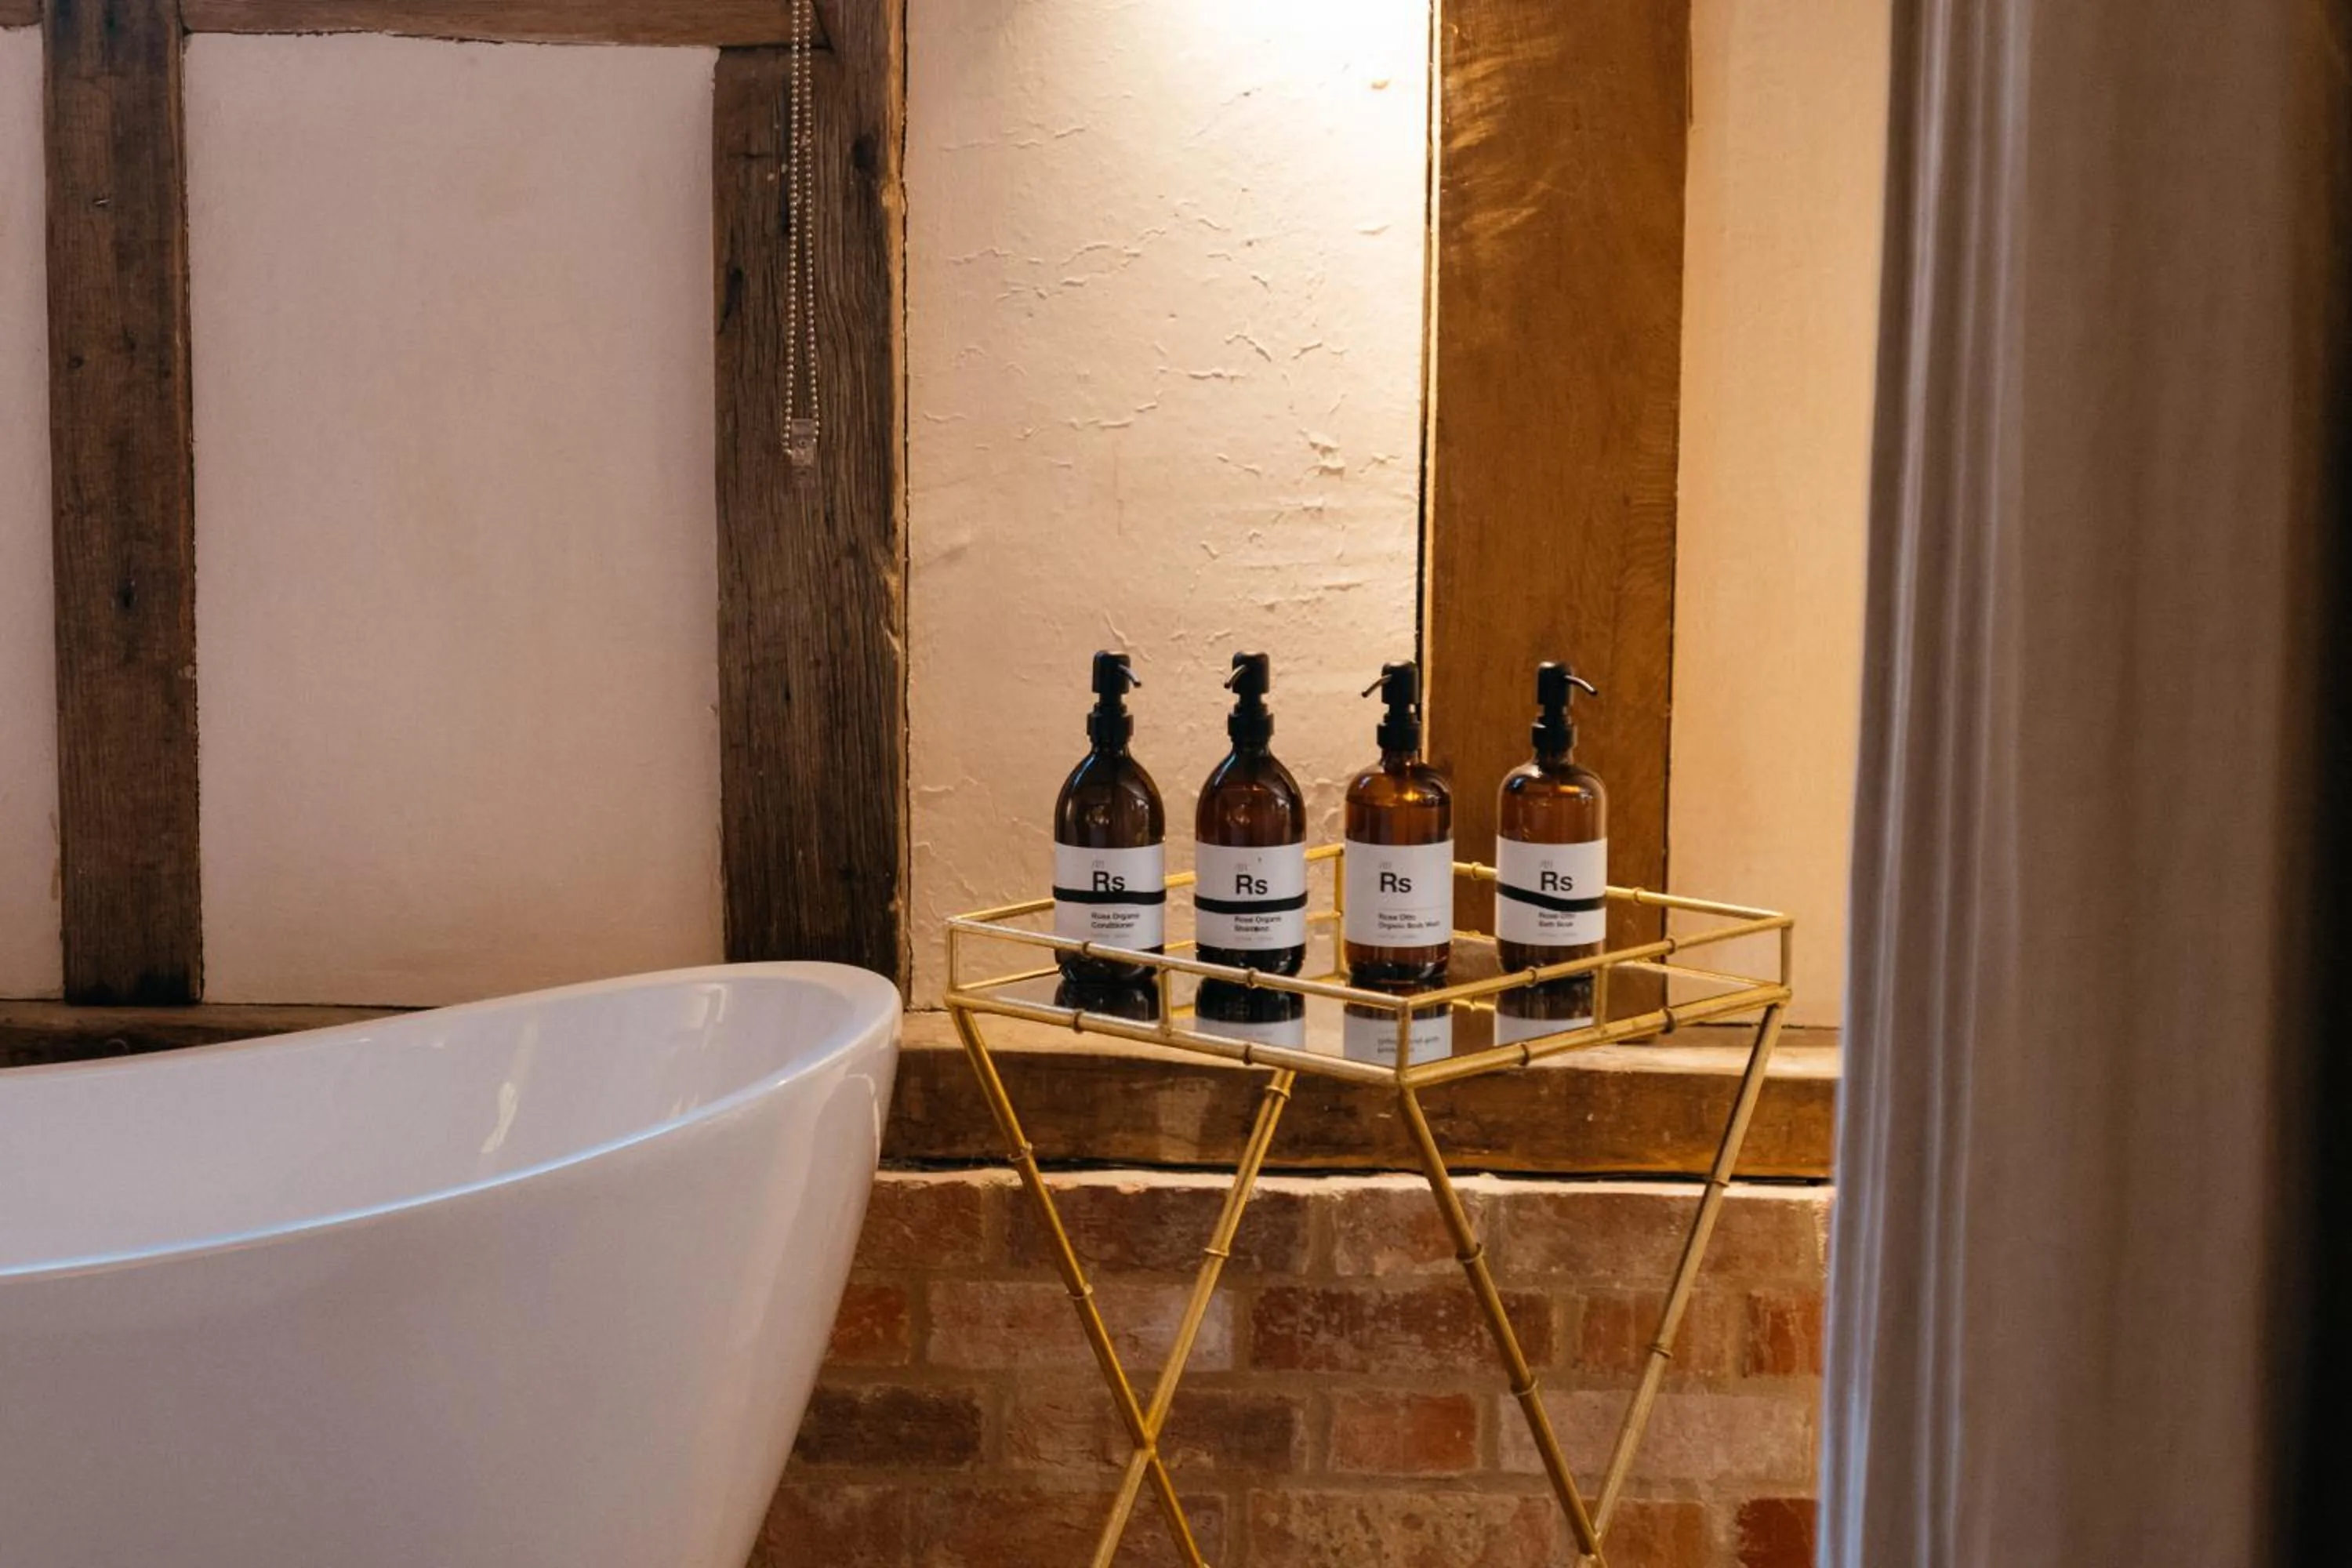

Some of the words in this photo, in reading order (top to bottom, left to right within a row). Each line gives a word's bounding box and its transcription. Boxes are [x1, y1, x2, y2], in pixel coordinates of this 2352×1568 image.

[1093, 870, 1125, 892] Rs
[1236, 873, 1268, 895] Rs
[1380, 872, 1412, 893] Rs
[1541, 871, 1573, 891] Rs
